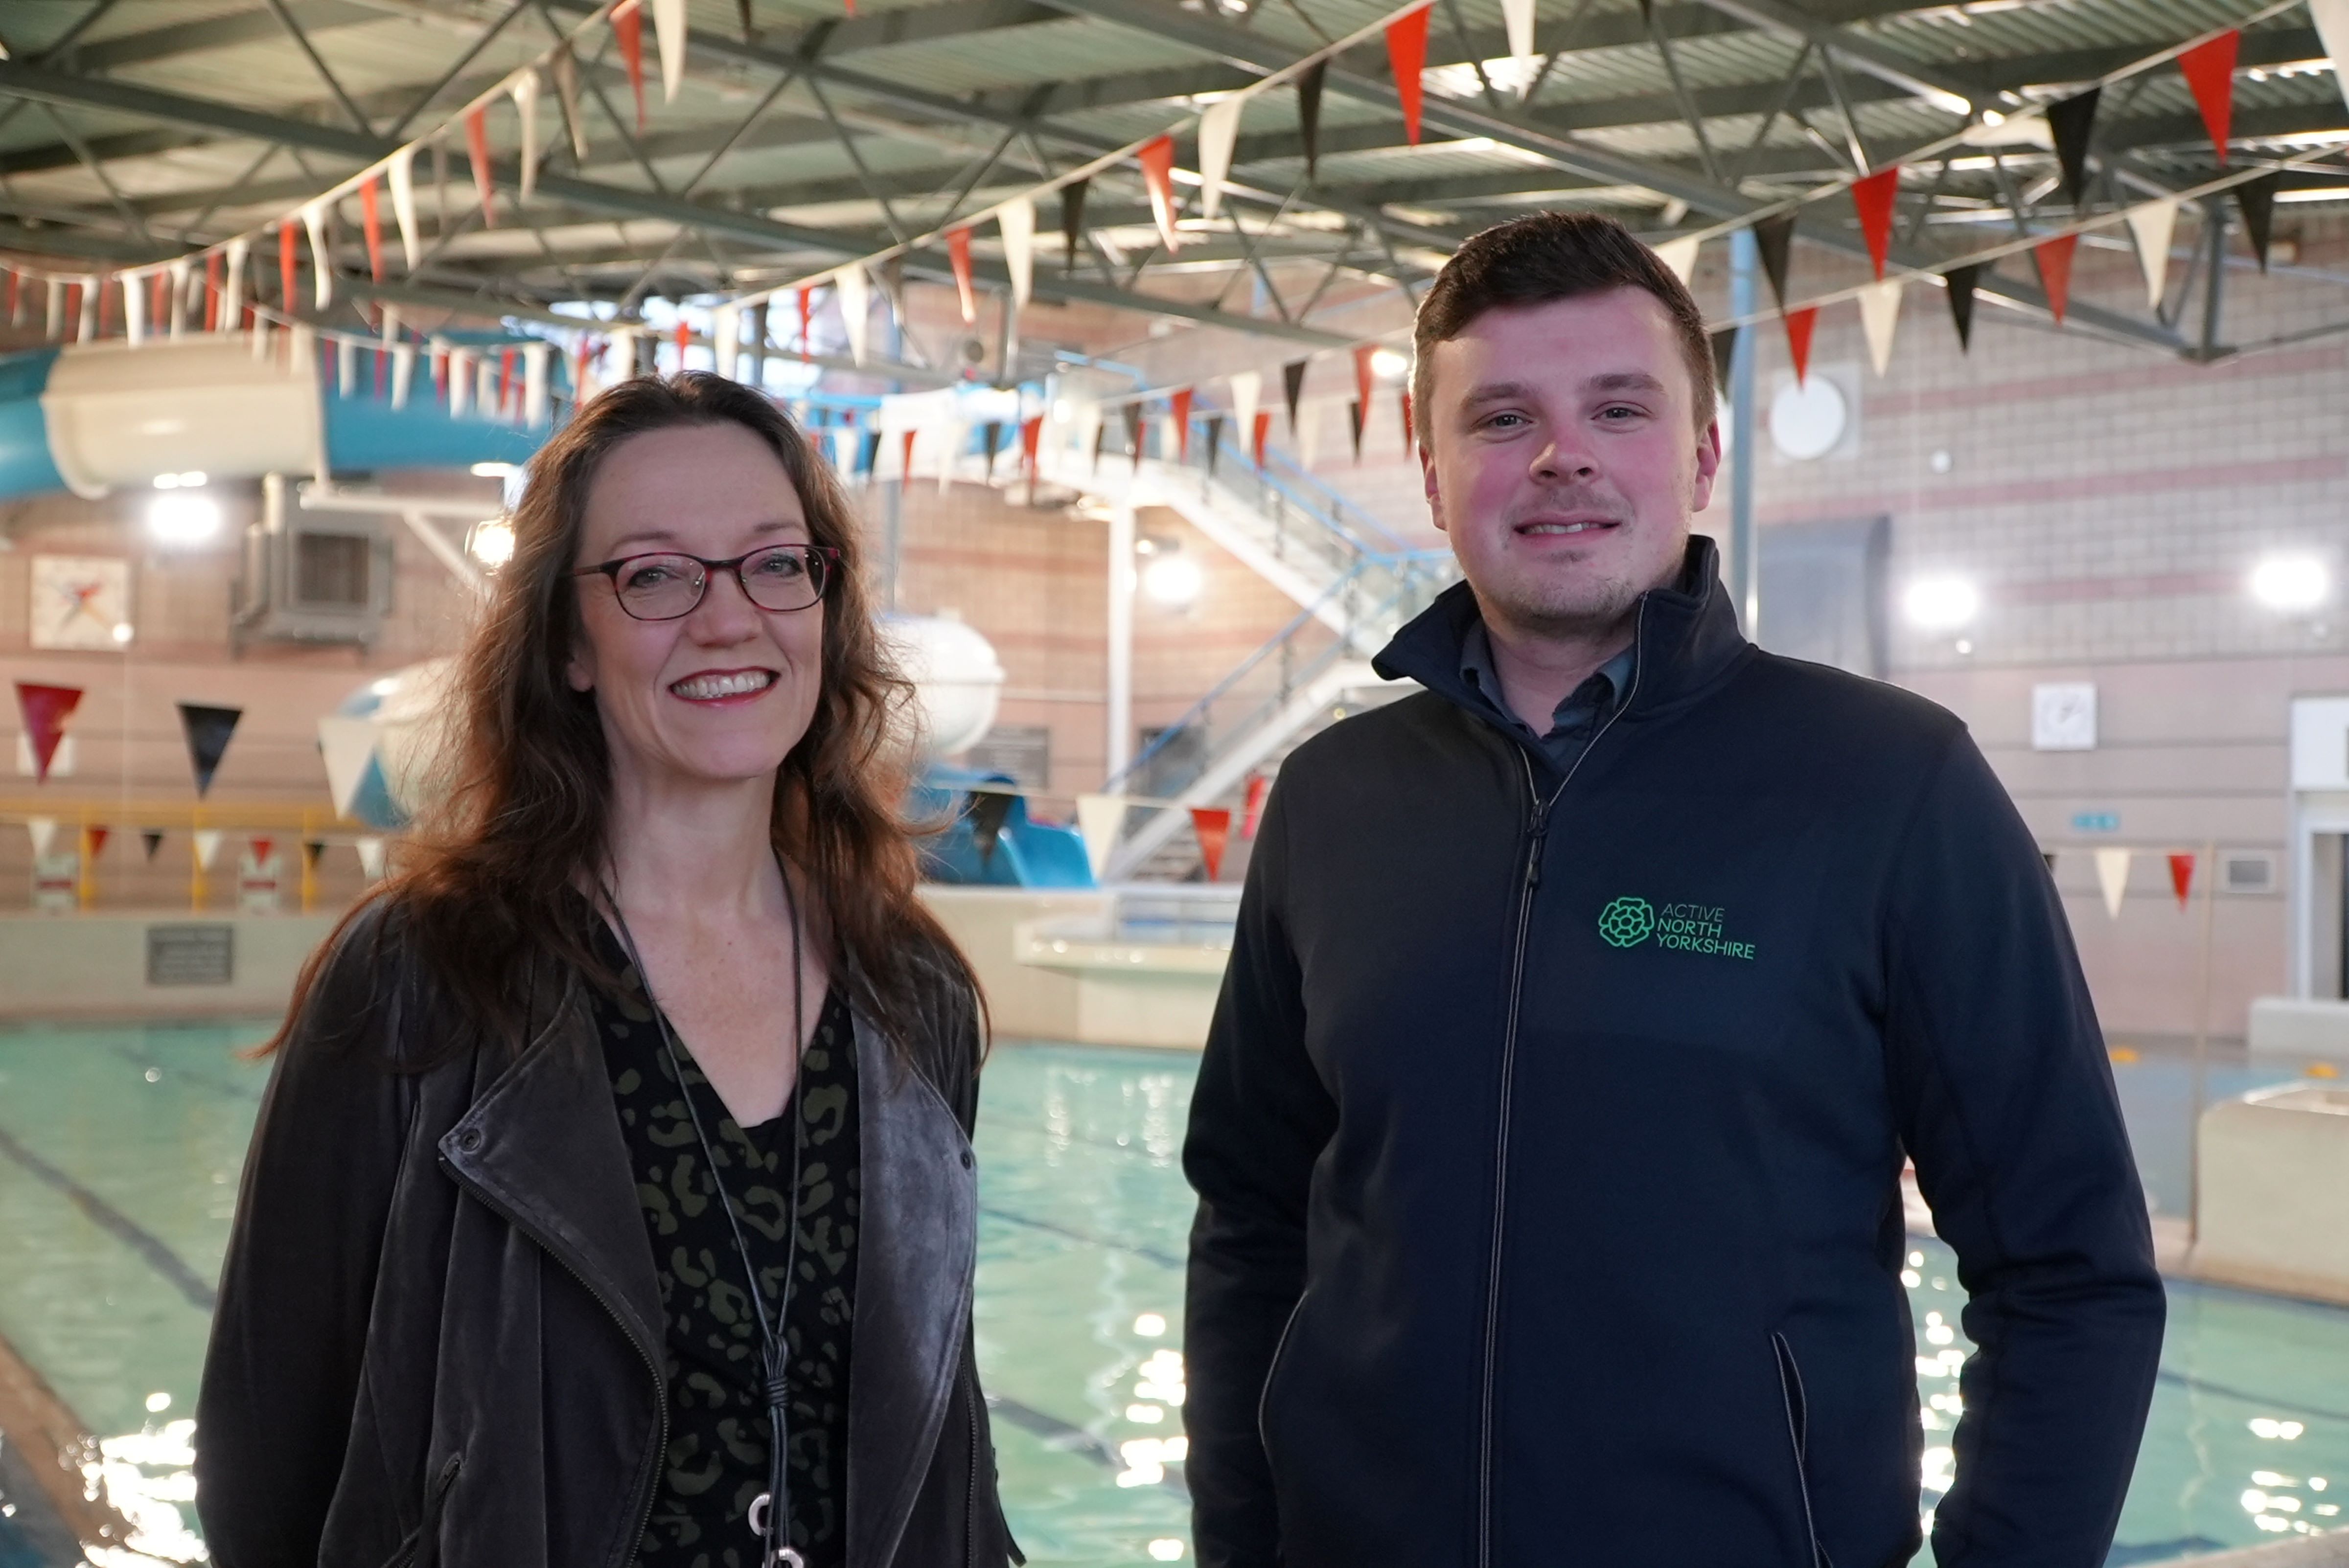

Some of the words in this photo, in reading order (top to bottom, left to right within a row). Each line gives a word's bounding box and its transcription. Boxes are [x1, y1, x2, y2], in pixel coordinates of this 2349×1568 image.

[1661, 903, 1725, 923] ACTIVE
[1657, 918, 1722, 938] NORTH
[1657, 932, 1756, 960] YORKSHIRE
